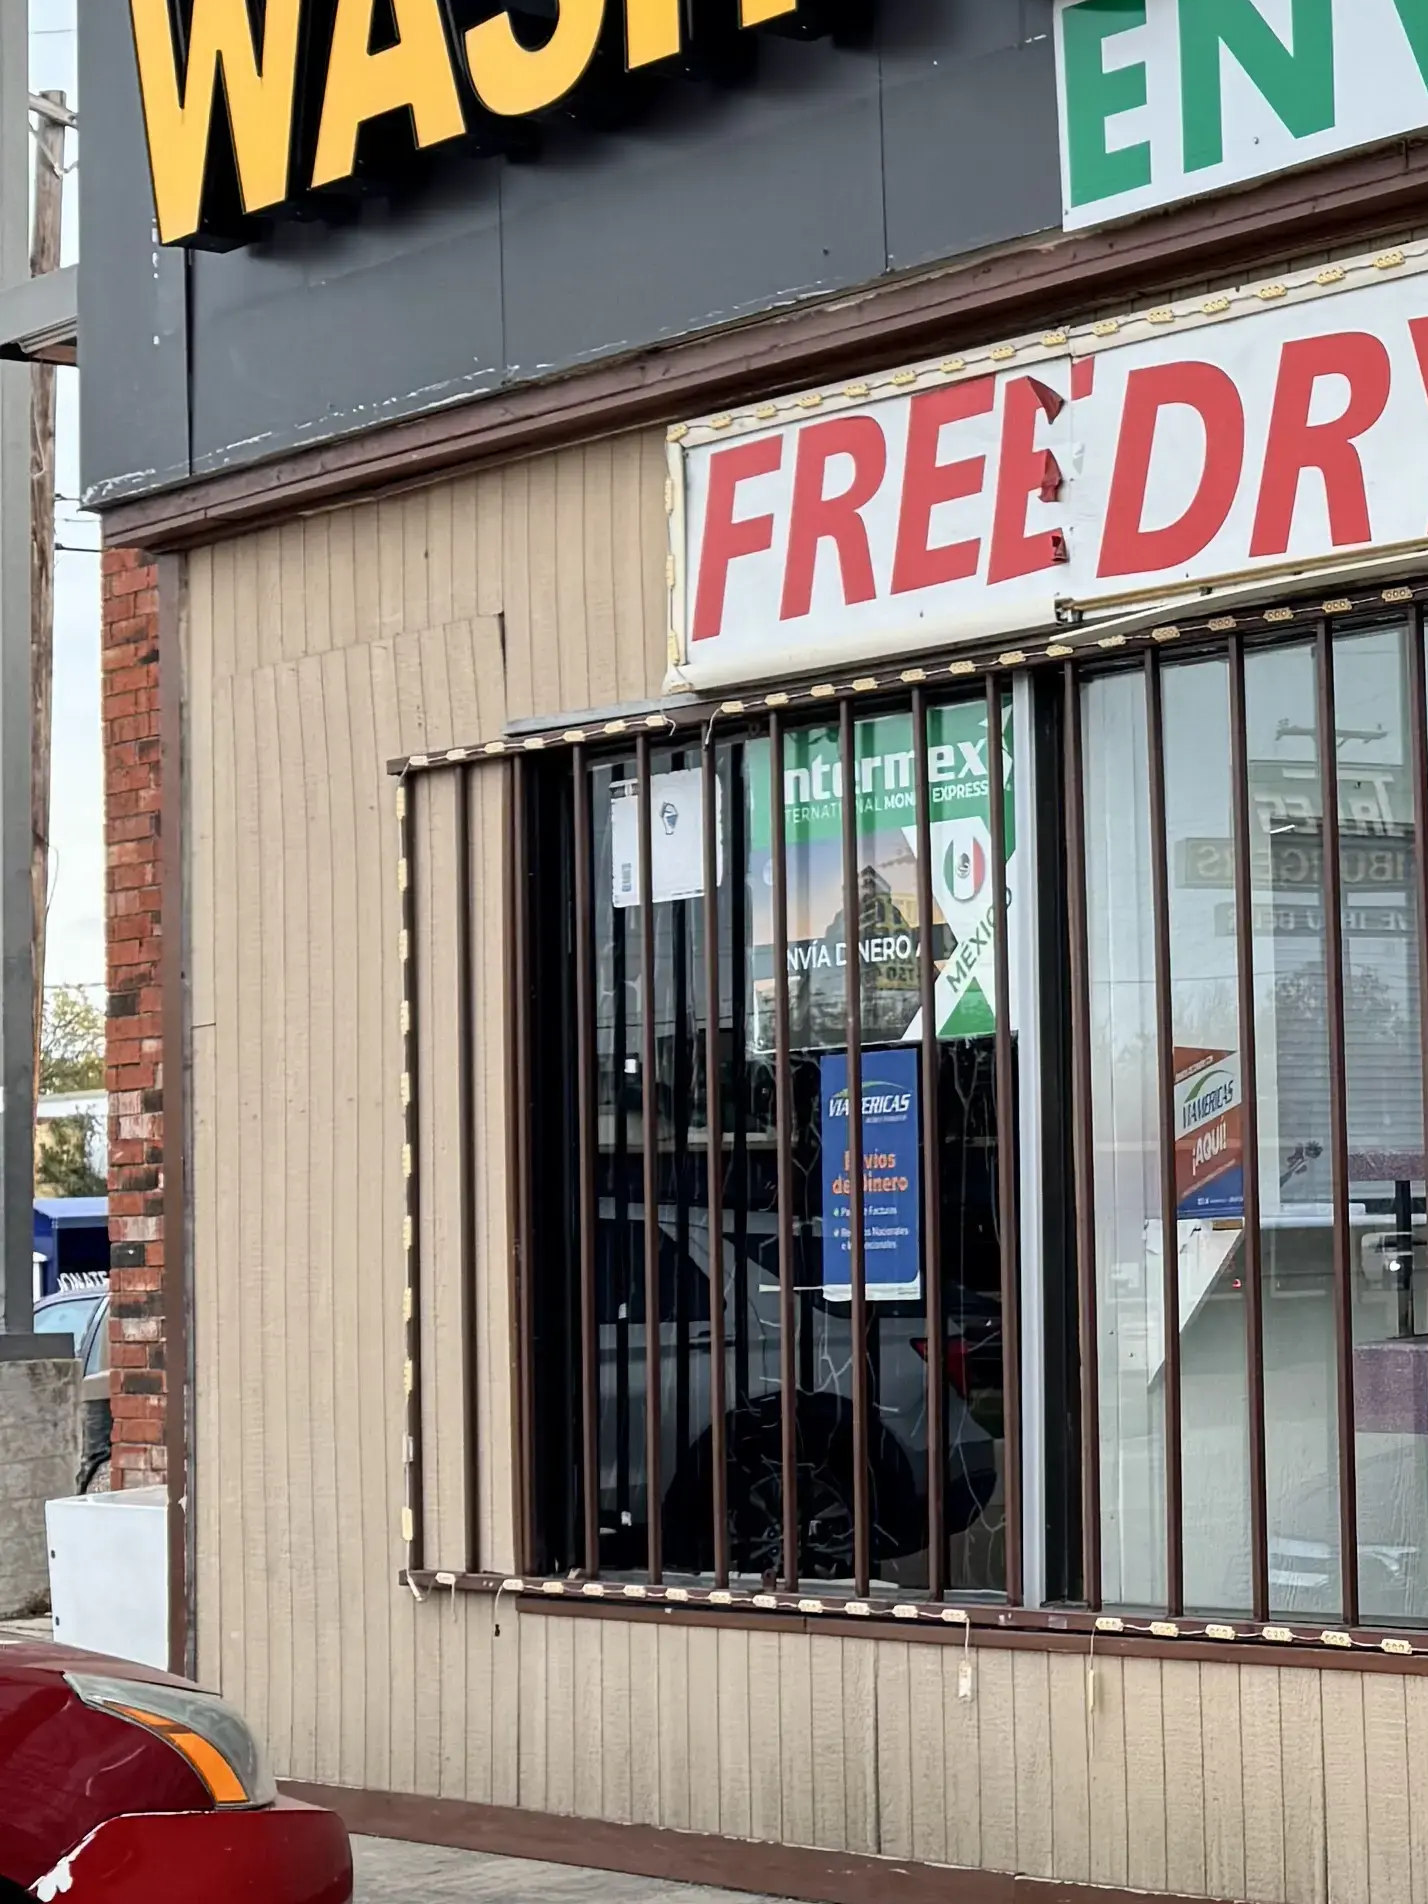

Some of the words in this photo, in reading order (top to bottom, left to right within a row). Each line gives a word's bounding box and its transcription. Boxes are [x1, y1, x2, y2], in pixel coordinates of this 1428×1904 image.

[692, 357, 1094, 642] FREE
[783, 797, 883, 824] TERNATINAL
[884, 794, 915, 811] MON
[932, 779, 990, 803] EXPRESS
[786, 939, 831, 971] NVÍA
[836, 934, 912, 965] DNERO
[829, 1093, 912, 1118] VIAERICAS
[864, 1169, 909, 1193] inero
